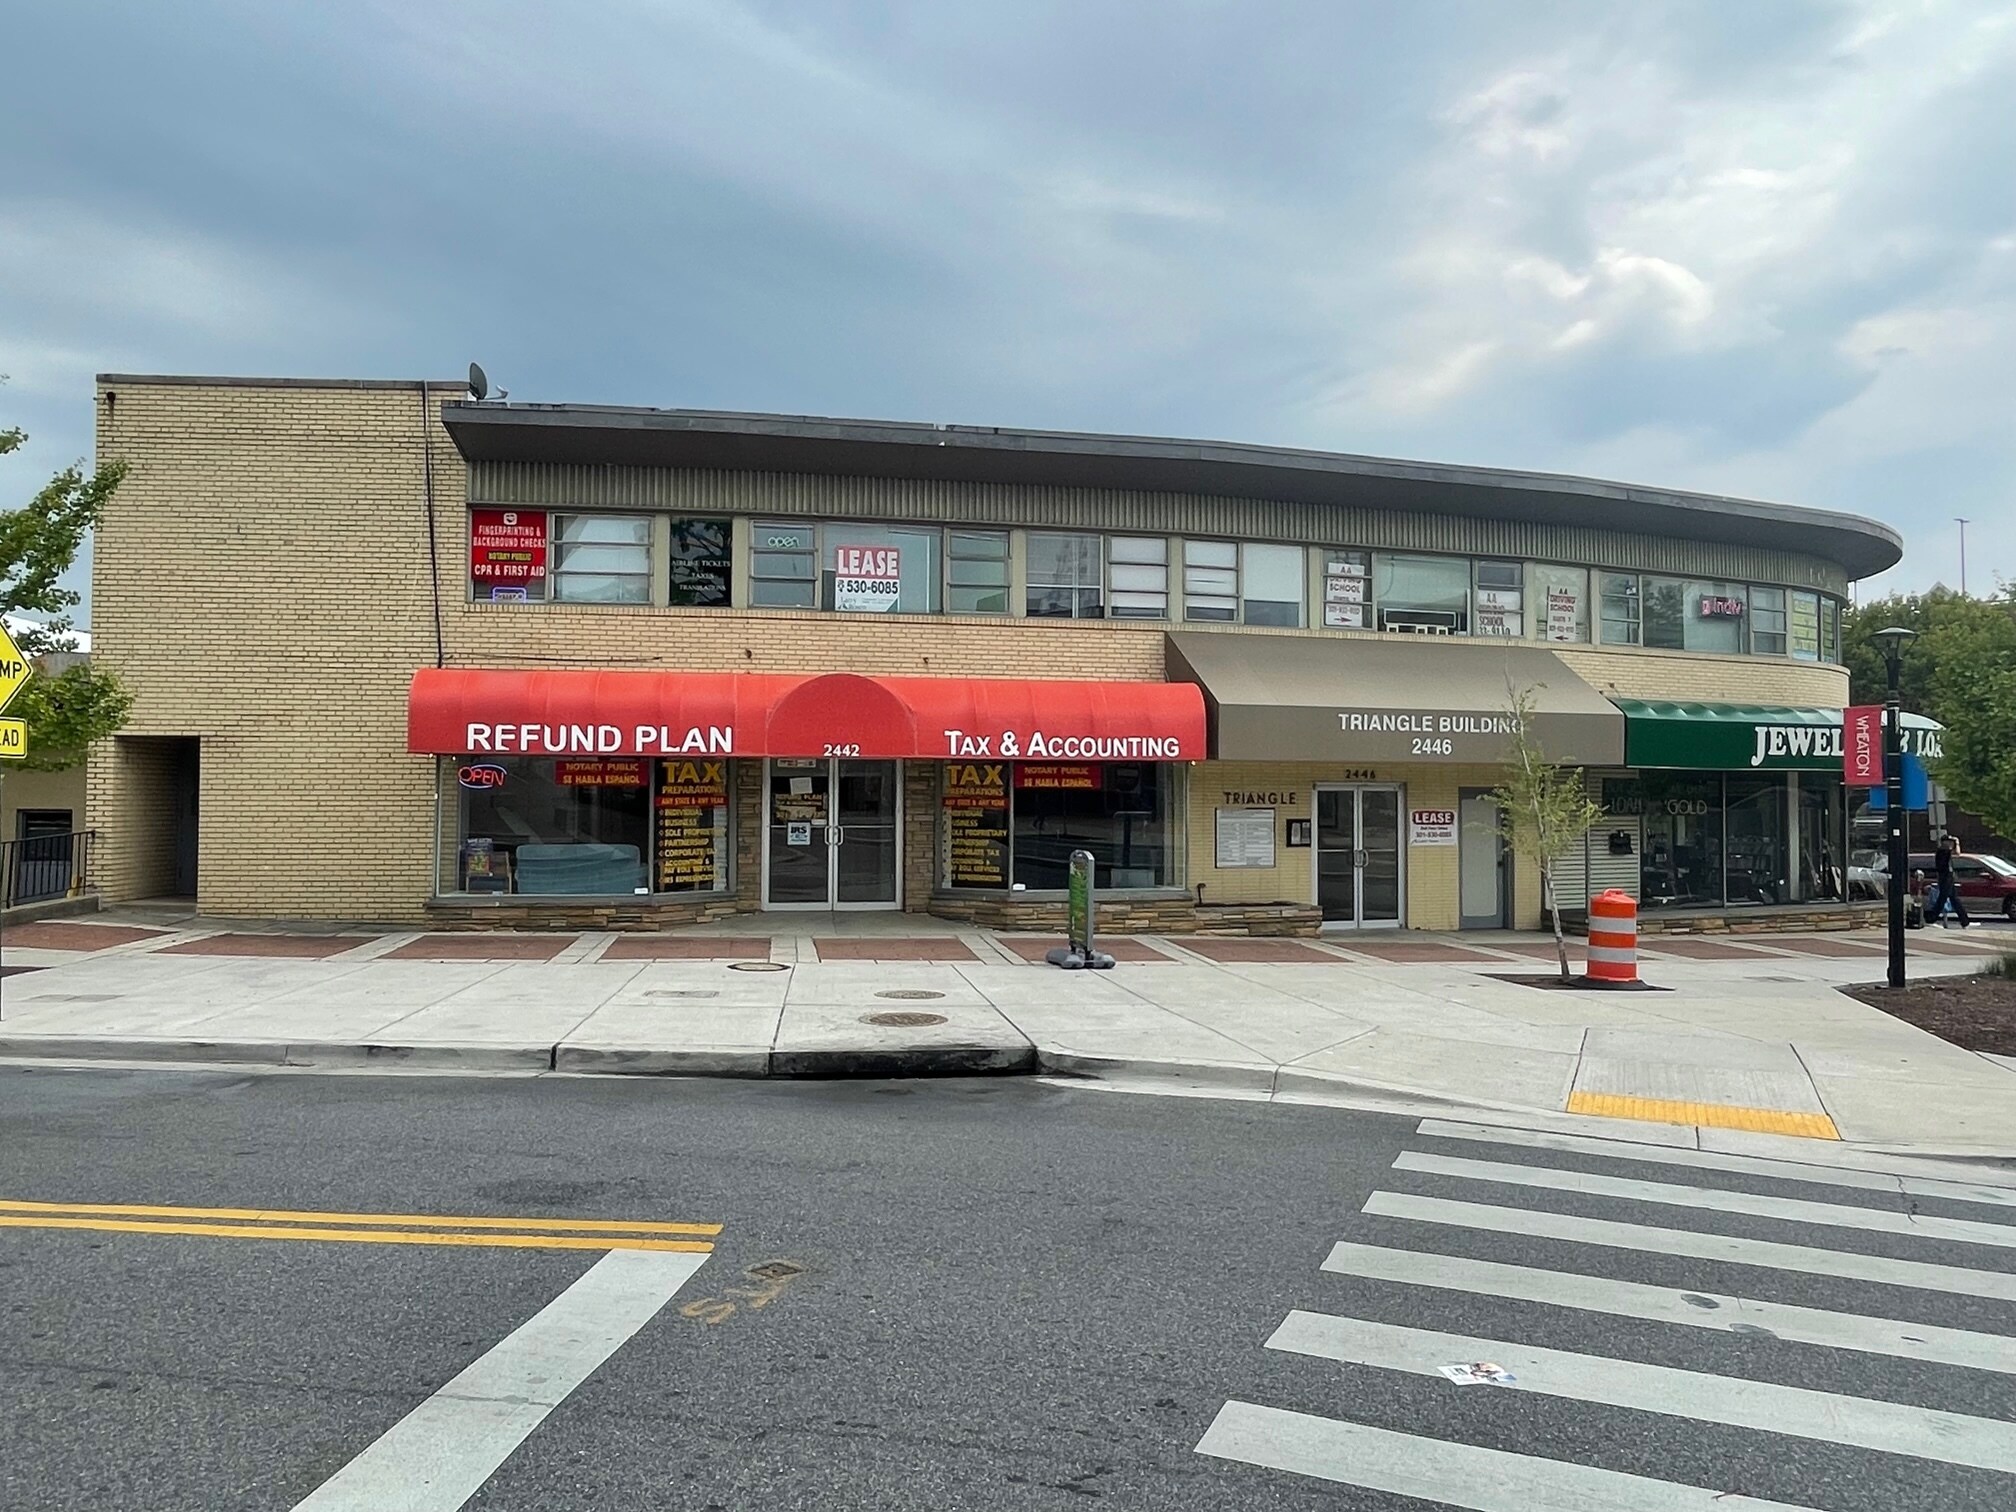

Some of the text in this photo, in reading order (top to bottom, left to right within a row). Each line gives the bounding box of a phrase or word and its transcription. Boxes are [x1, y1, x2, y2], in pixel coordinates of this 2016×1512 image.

[478, 525, 541, 537] FINGERPRINTING &
[473, 537, 546, 548] BACKGROUND CHECKS
[838, 549, 898, 576] LEASE
[474, 564, 545, 576] CPR & FIRST AID
[846, 580, 898, 594] 530-6085
[1330, 583, 1361, 593] SCHOOL
[0, 661, 22, 679] MP
[1338, 714, 1433, 733] TRIANGLE
[466, 723, 733, 754] REFUND PLAN
[999, 731, 1020, 757] &
[823, 744, 860, 757] 2442
[1411, 738, 1453, 755] 2446
[1751, 727, 1845, 767] JEWEL
[1856, 715, 1870, 777] WHEATON
[565, 763, 639, 771] NOTARY PUBLIC
[662, 762, 721, 783] TAX
[1060, 767, 1088, 775] PUBLIC
[458, 766, 504, 786] OPEN
[563, 772, 640, 784] SE HABLA ESPAÑOL
[946, 765, 1004, 785] TAX
[1345, 769, 1376, 779] 2446
[1223, 792, 1296, 805] TRIANGLE
[1670, 799, 1707, 815] GOLD
[1415, 812, 1452, 823] LEASE
[664, 828, 682, 837] SOLE
[791, 826, 807, 834] IRS
[986, 848, 1000, 857] TAX
